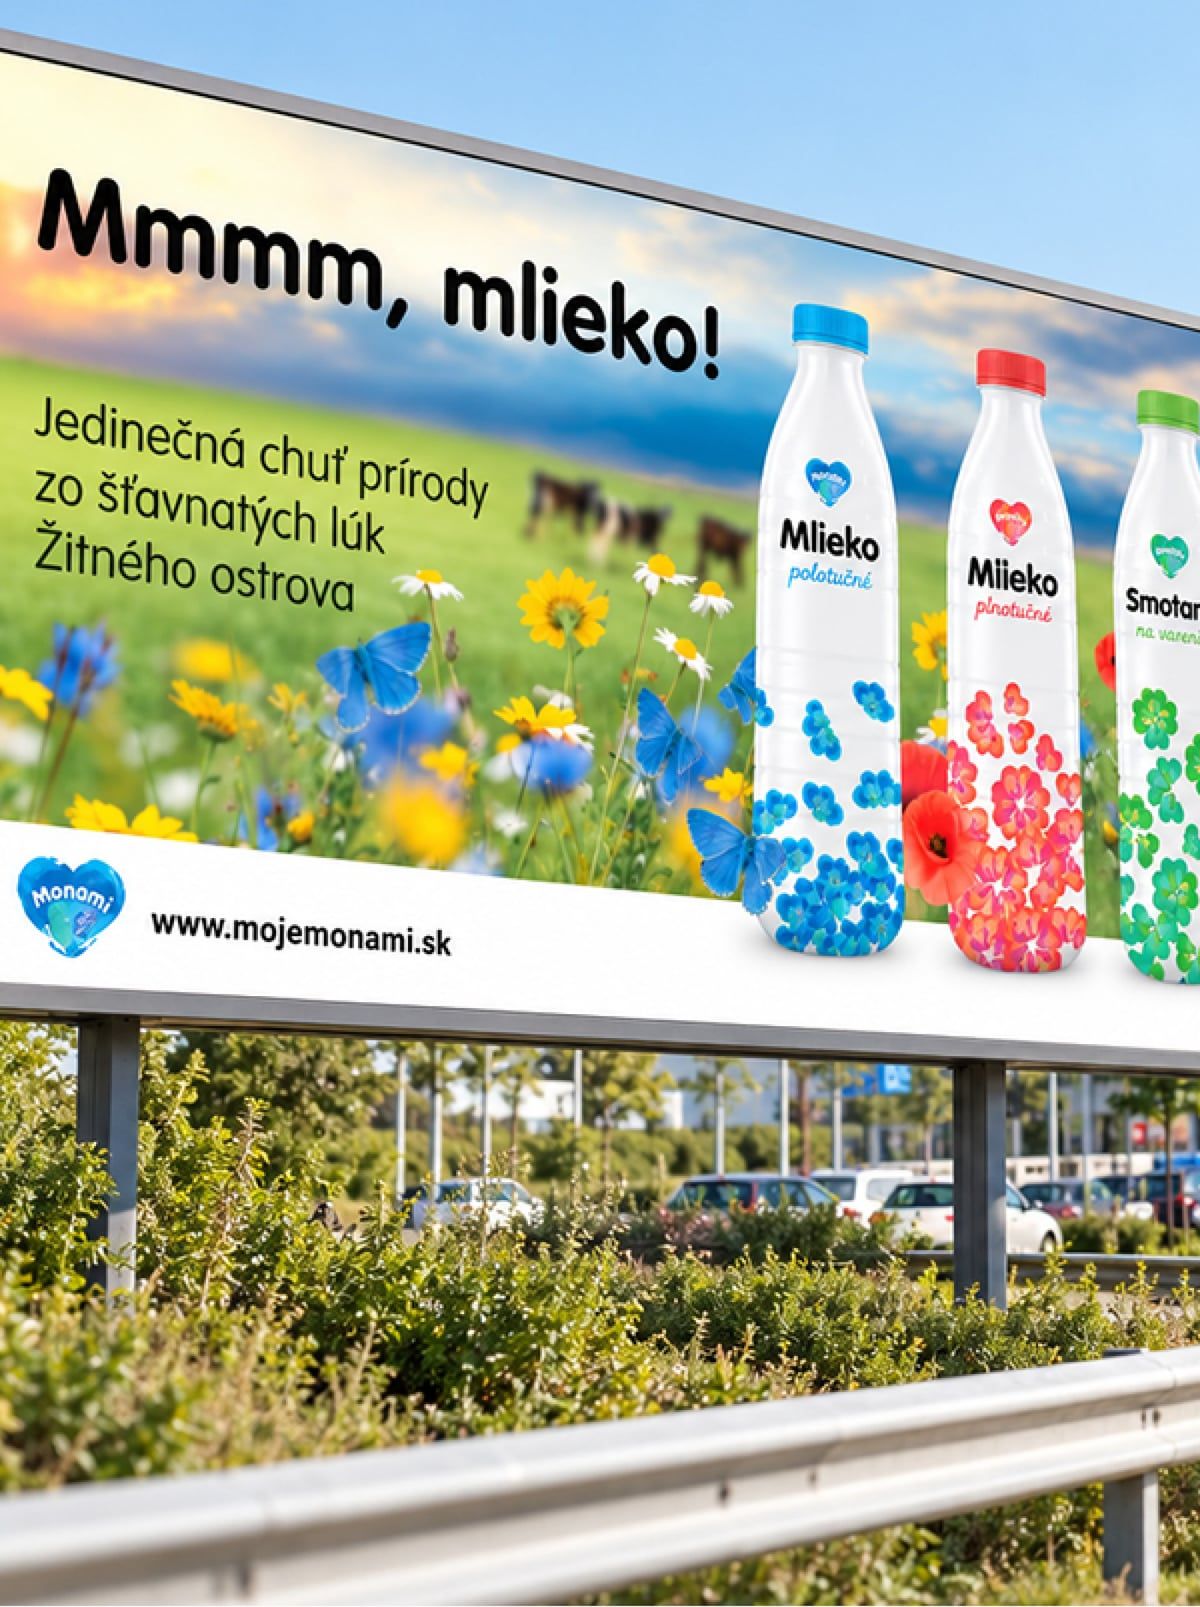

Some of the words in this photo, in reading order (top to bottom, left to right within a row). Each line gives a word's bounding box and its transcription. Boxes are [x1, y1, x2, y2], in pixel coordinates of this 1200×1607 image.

[37, 168, 408, 329] Mmmm,
[443, 259, 719, 380] mlieko!
[34, 397, 245, 470] Jedinečná
[259, 434, 349, 486] chuť
[359, 456, 489, 520] prírody
[35, 470, 83, 508] zo
[97, 471, 316, 548] šťavnatých
[331, 505, 386, 556] lúk
[779, 517, 880, 563] Mlieko
[35, 519, 197, 590] Žitného
[211, 561, 355, 613] ostrova
[31, 884, 114, 914] Monami
[151, 912, 452, 957] www.mojemonami.sk
